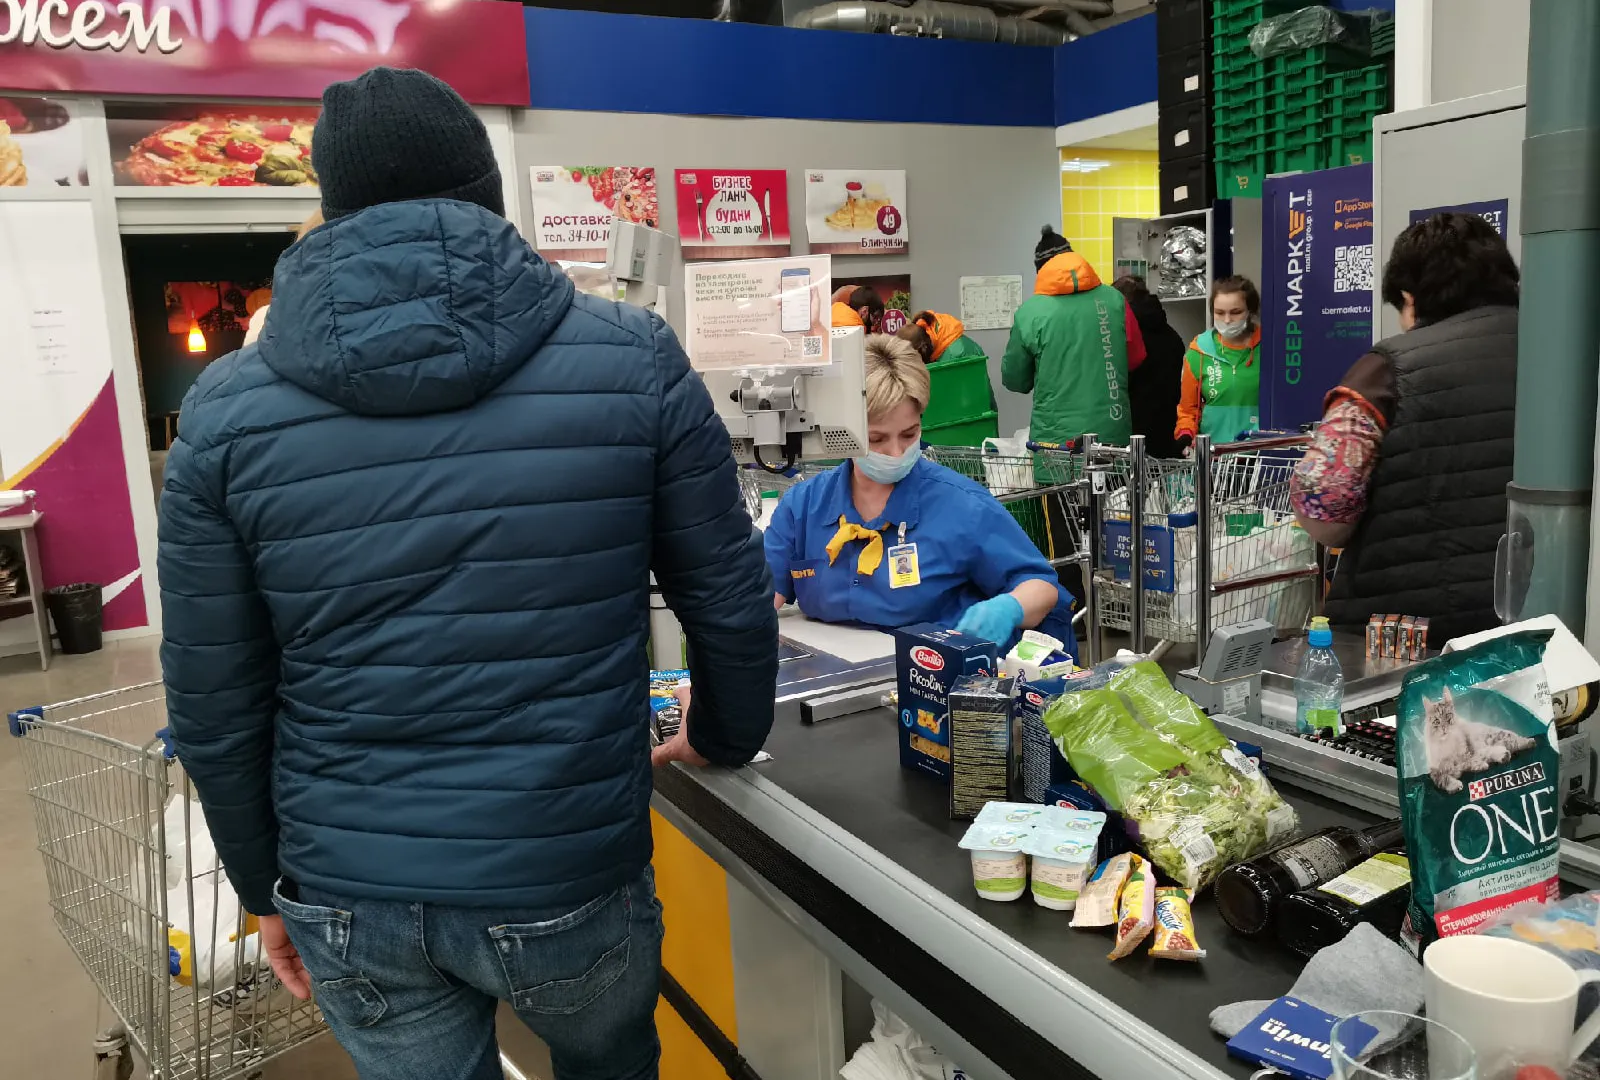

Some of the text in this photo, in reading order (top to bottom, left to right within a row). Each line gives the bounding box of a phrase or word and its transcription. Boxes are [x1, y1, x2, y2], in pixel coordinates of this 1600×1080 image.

[713, 177, 752, 189] БИЗНЕС
[720, 190, 747, 202] ЛАНЧ
[1343, 203, 1358, 212] App
[543, 214, 611, 227] доставка
[882, 213, 896, 228] 49
[733, 226, 743, 235] до
[1305, 216, 1314, 243] group
[885, 317, 903, 333] 150
[917, 650, 942, 667] Barilla
[650, 671, 689, 680] always
[909, 668, 944, 693] Piccolini
[1484, 763, 1544, 795] PURINA
[1450, 789, 1557, 865] ONE
